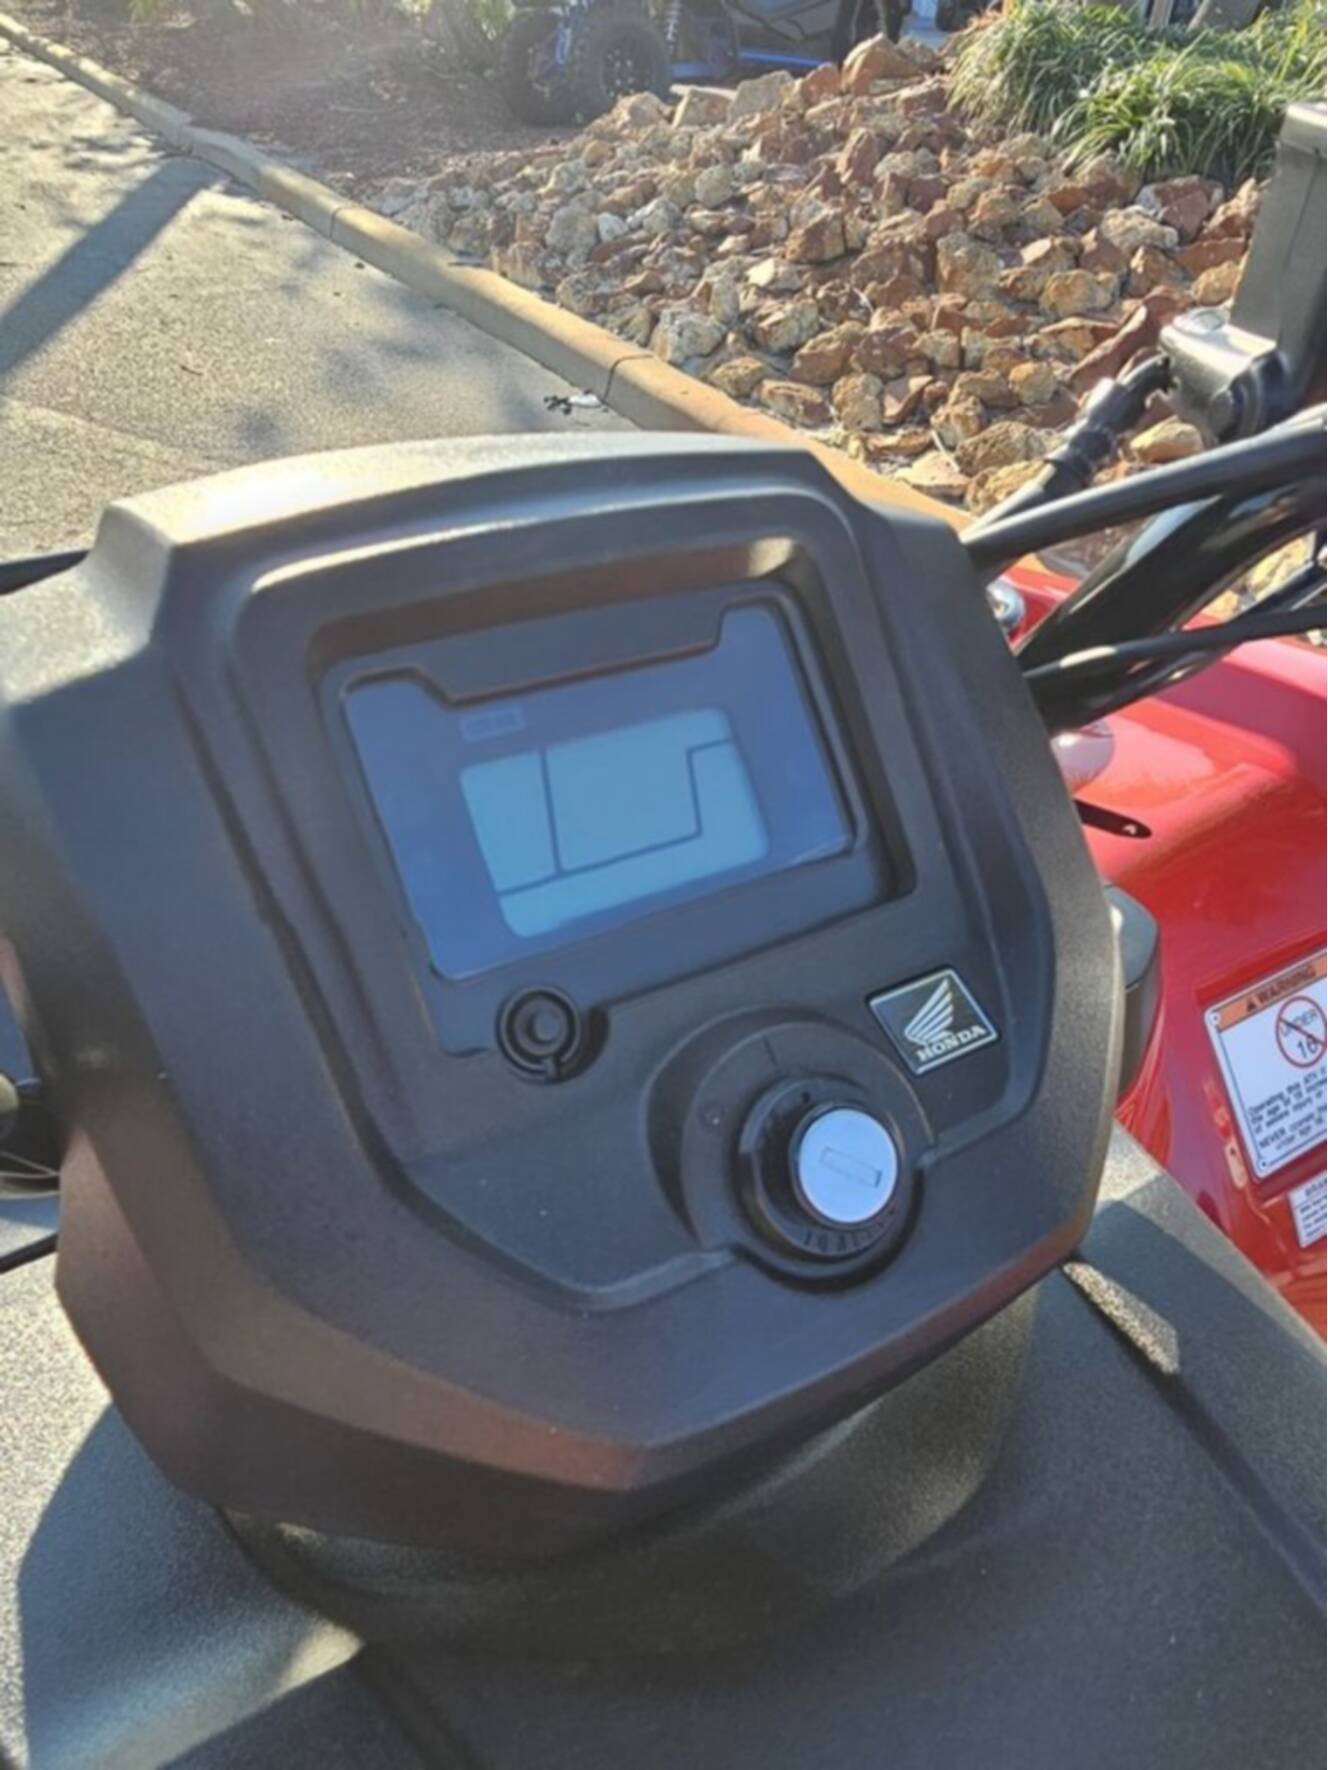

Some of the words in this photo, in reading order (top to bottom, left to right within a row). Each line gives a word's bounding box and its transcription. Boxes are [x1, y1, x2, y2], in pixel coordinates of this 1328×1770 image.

[1257, 964, 1317, 1004] WARNING
[917, 1025, 986, 1062] HONDA
[1297, 1034, 1319, 1059] 16
